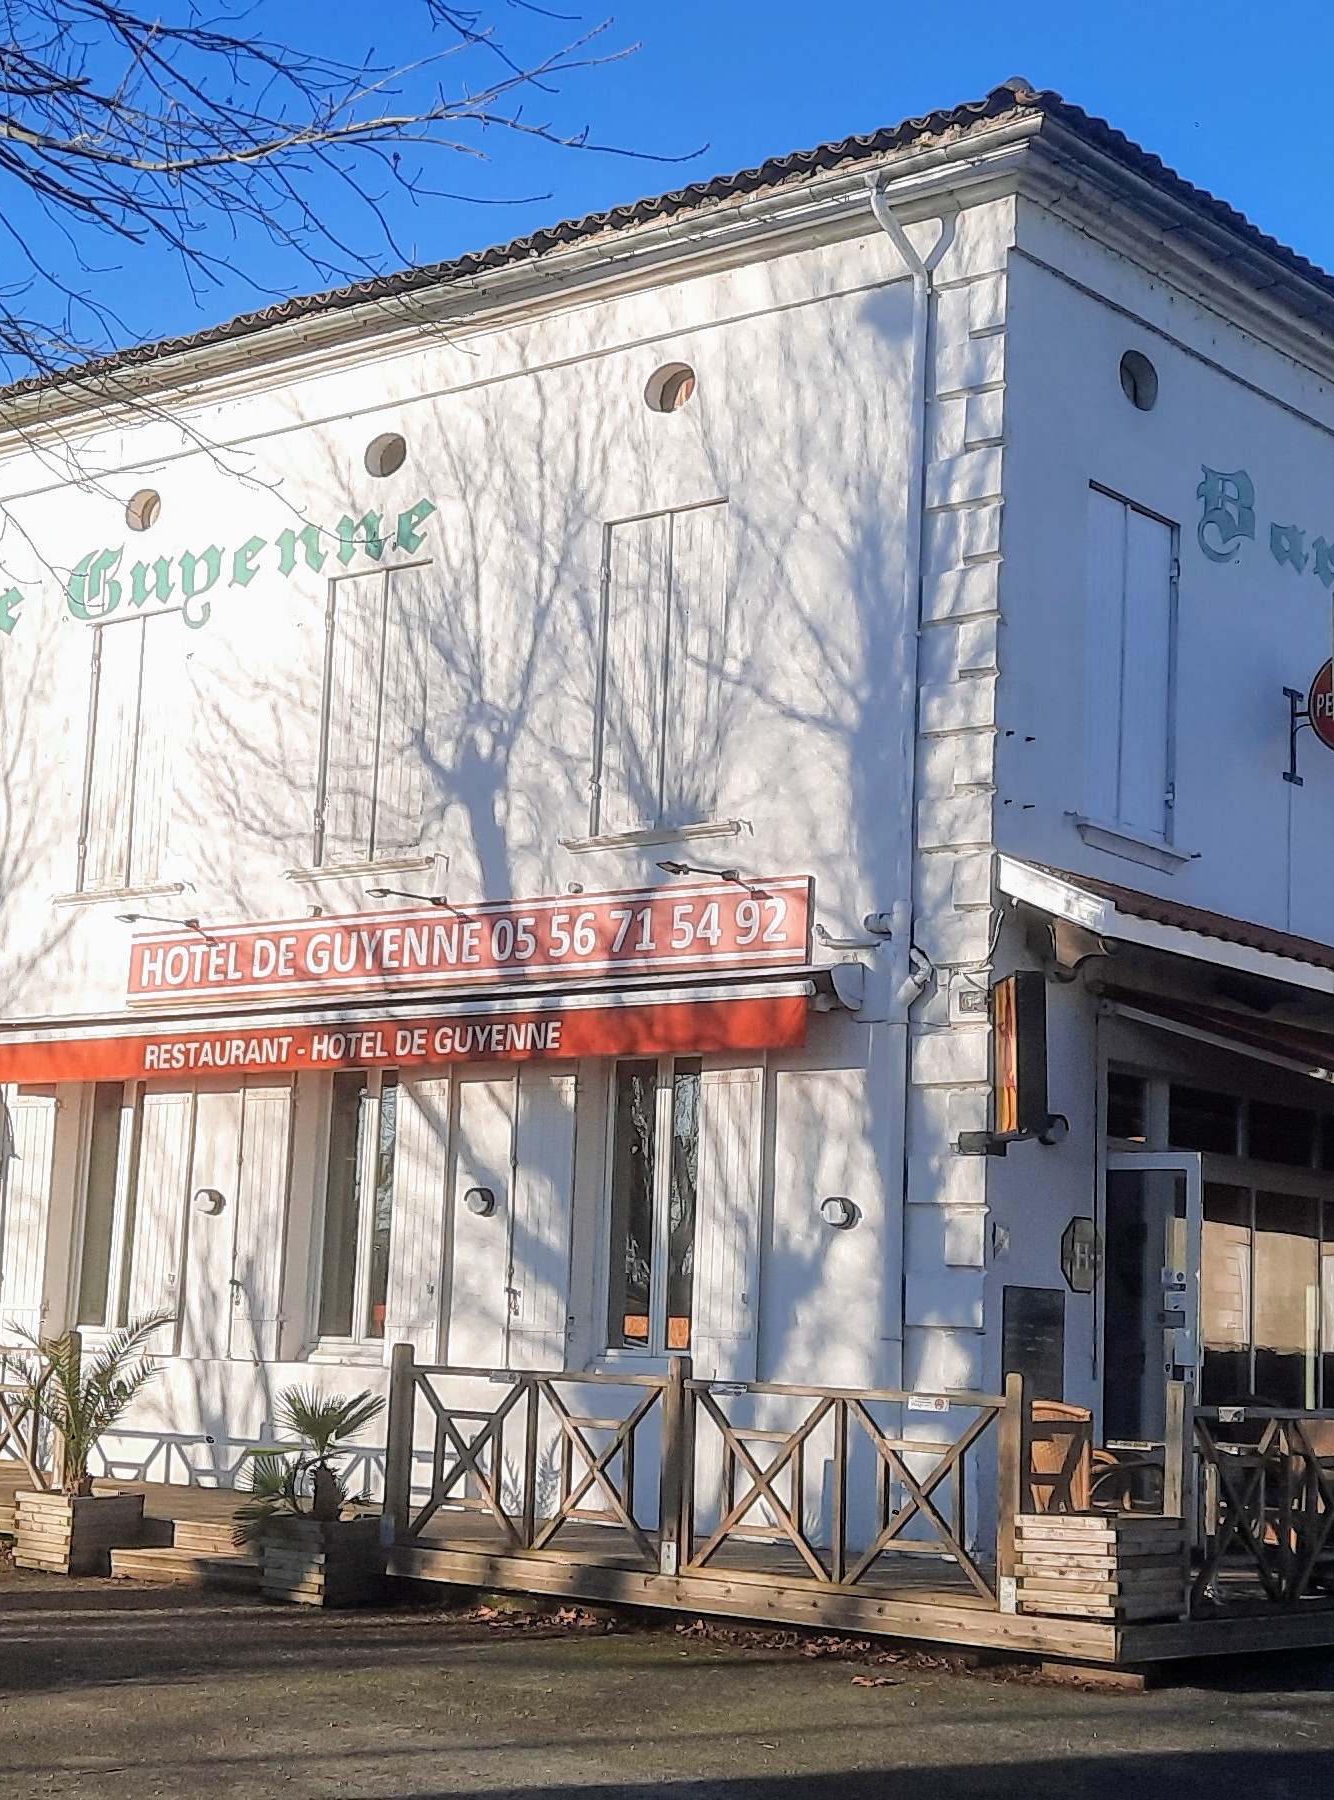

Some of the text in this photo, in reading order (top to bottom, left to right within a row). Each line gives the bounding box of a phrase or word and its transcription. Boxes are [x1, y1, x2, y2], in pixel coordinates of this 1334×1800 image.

[67, 498, 436, 629] Guyenne
[141, 897, 788, 987] HOTEL DE GUYENNE 05 56 71 54 92
[144, 1036, 294, 1070] RESTAURANT
[311, 1030, 388, 1062] HOTEL
[395, 1028, 430, 1056] DE
[433, 1021, 562, 1055] GUYENNE
